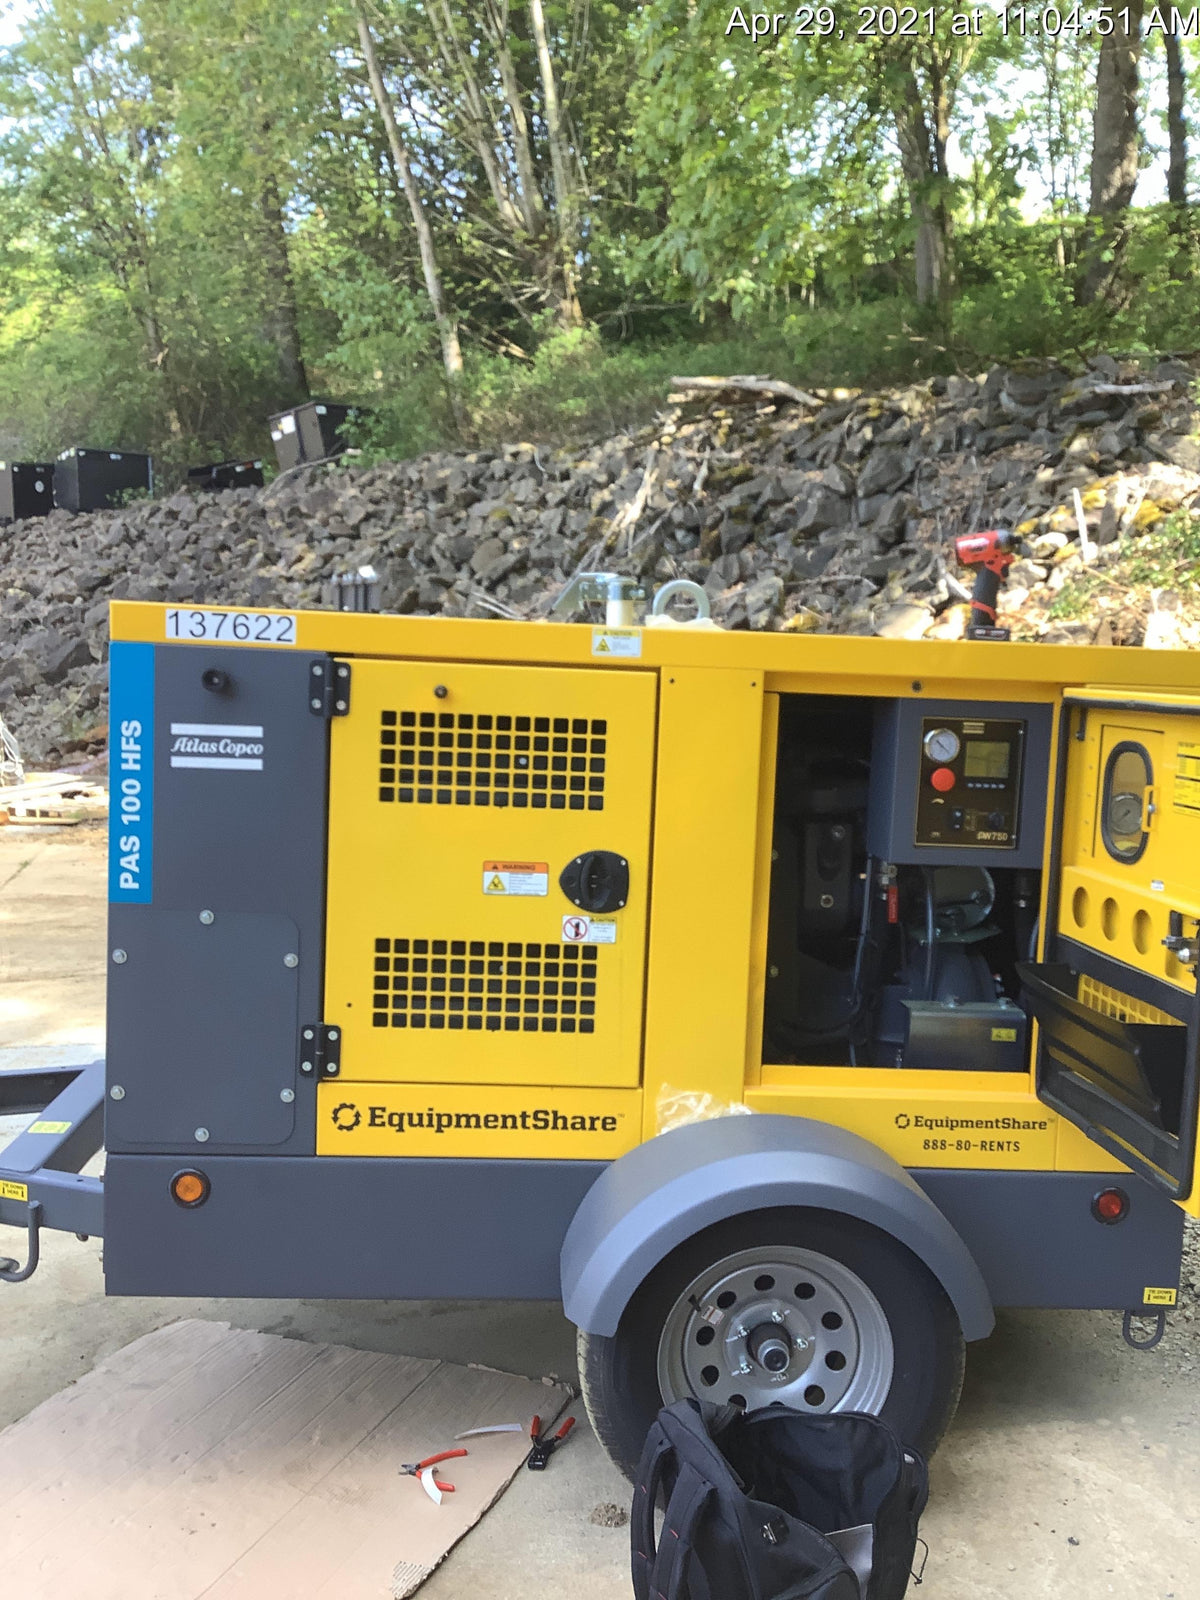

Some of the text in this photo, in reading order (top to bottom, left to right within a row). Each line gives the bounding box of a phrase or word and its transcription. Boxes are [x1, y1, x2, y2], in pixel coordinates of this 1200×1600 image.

[168, 610, 294, 642] 137622
[119, 720, 142, 890] PAS 100 HFS
[367, 1106, 617, 1133] EquipmentShare
[914, 1116, 1048, 1131] EquipmentShare
[923, 1139, 1021, 1152] 888-80-RENTS
